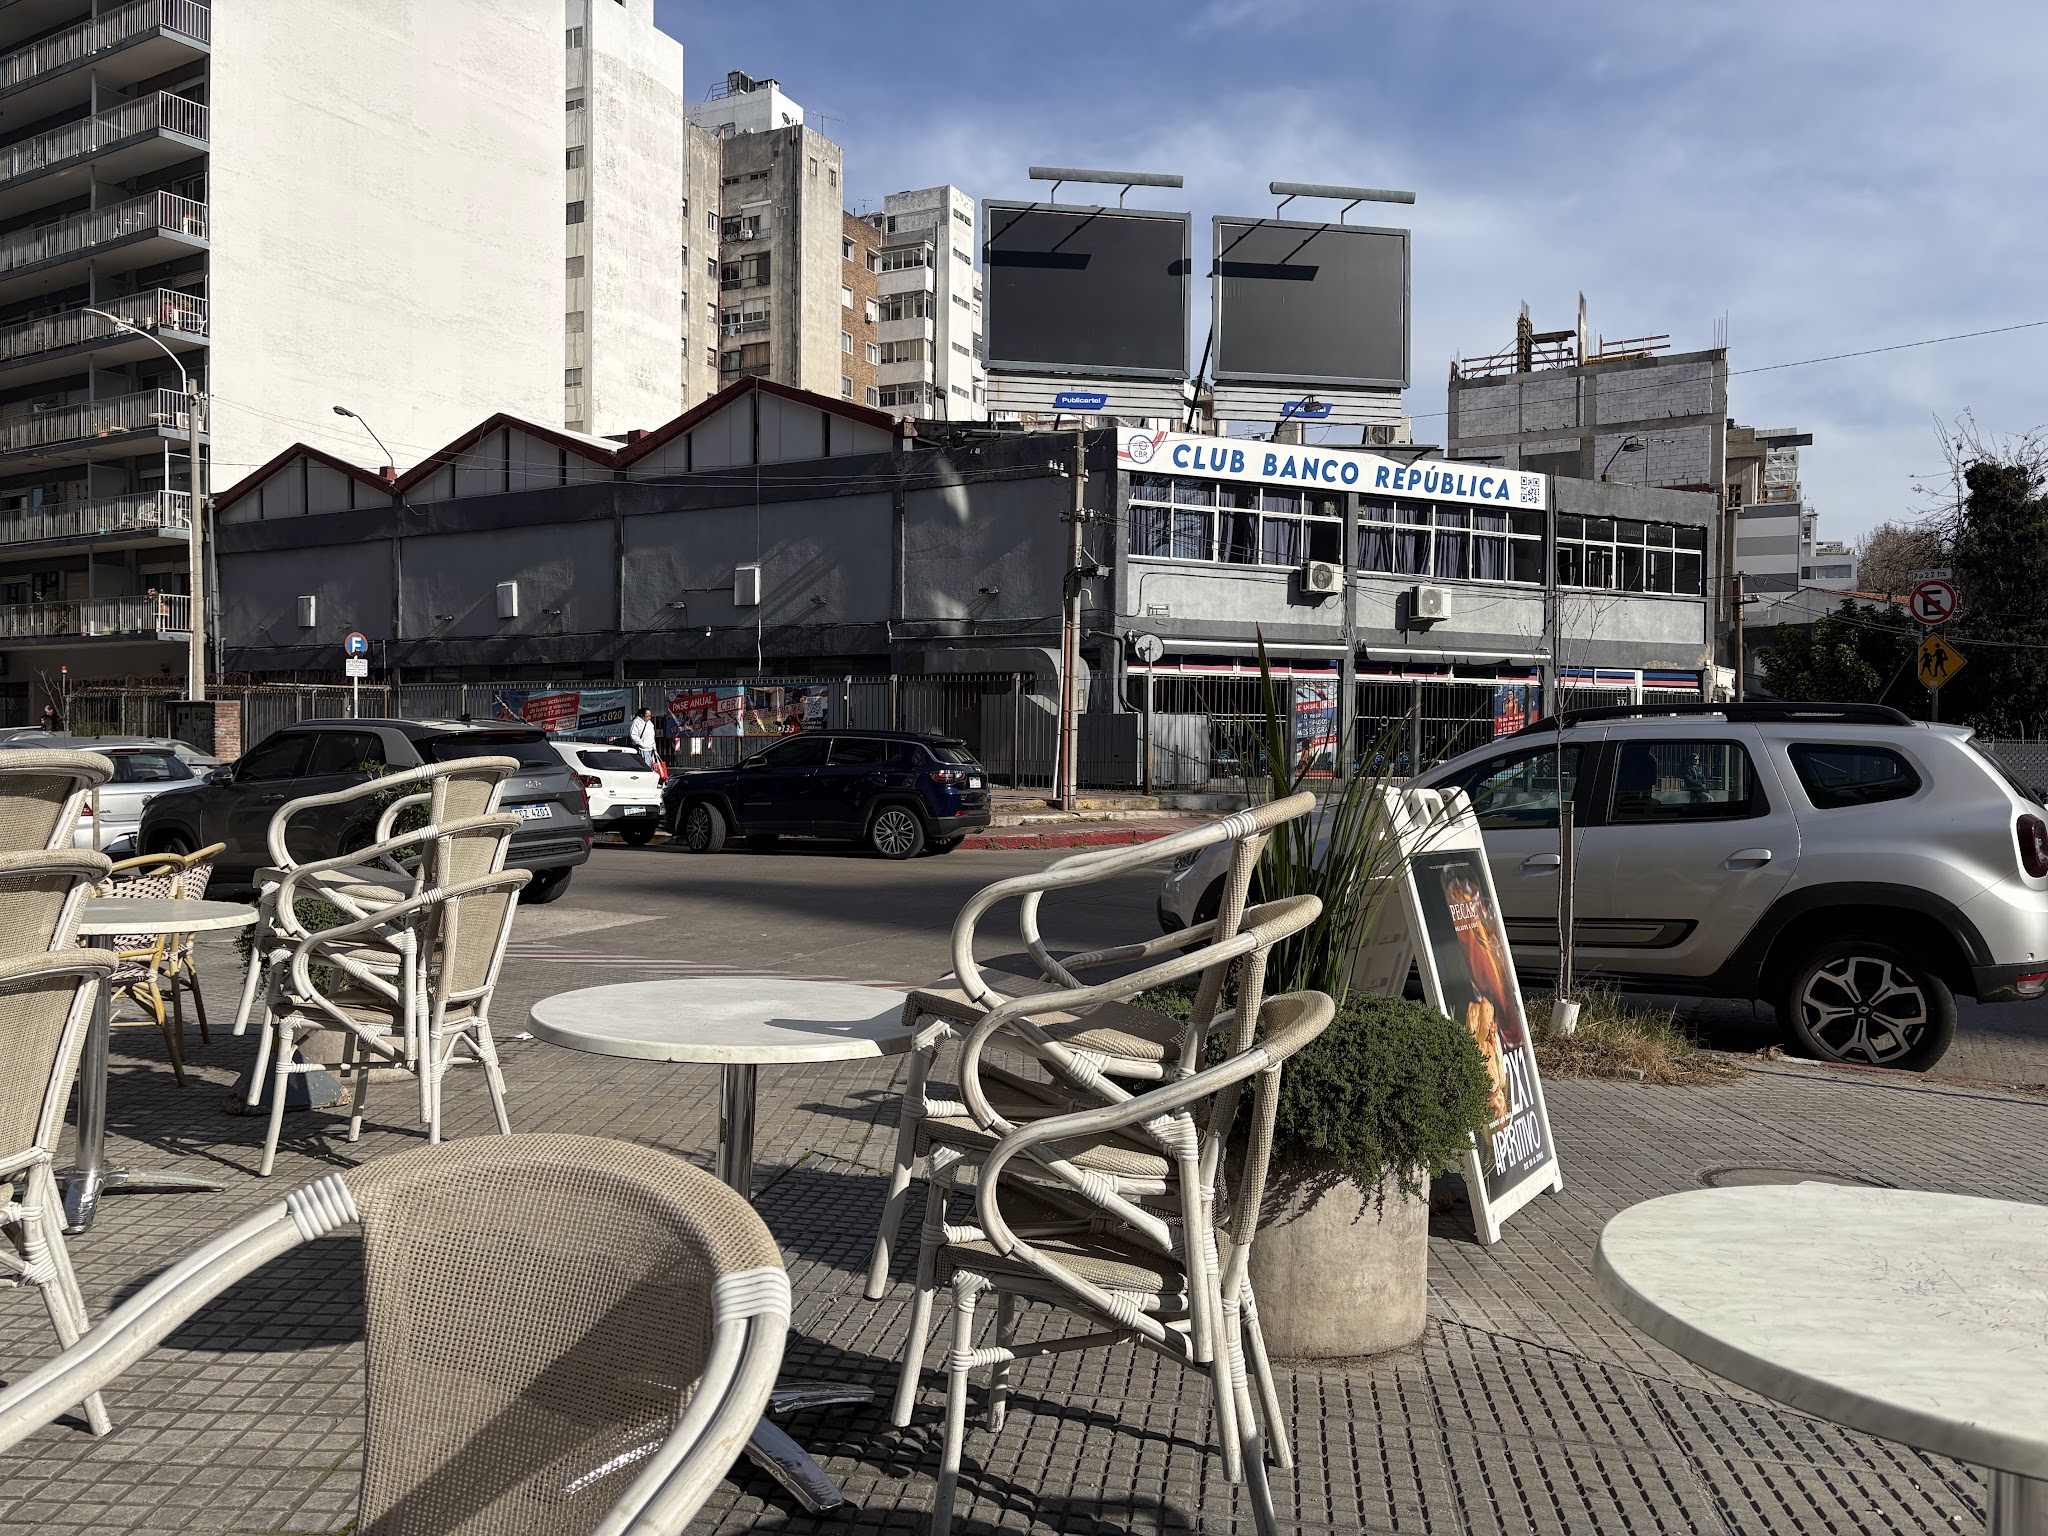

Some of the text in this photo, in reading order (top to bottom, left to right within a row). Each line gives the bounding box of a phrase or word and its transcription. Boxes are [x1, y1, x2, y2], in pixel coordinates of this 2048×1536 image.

[1134, 450, 1148, 459] CBR
[1172, 444, 1510, 500] CLUB BANCO REPÚBLICA
[672, 696, 713, 711] PASE ANUAL
[721, 699, 736, 711] CBR
[531, 807, 550, 818] 4201
[1449, 901, 1476, 921] PECAS
[1503, 1046, 1534, 1116] 2X1
[1492, 1110, 1541, 1177] APERITIVO
